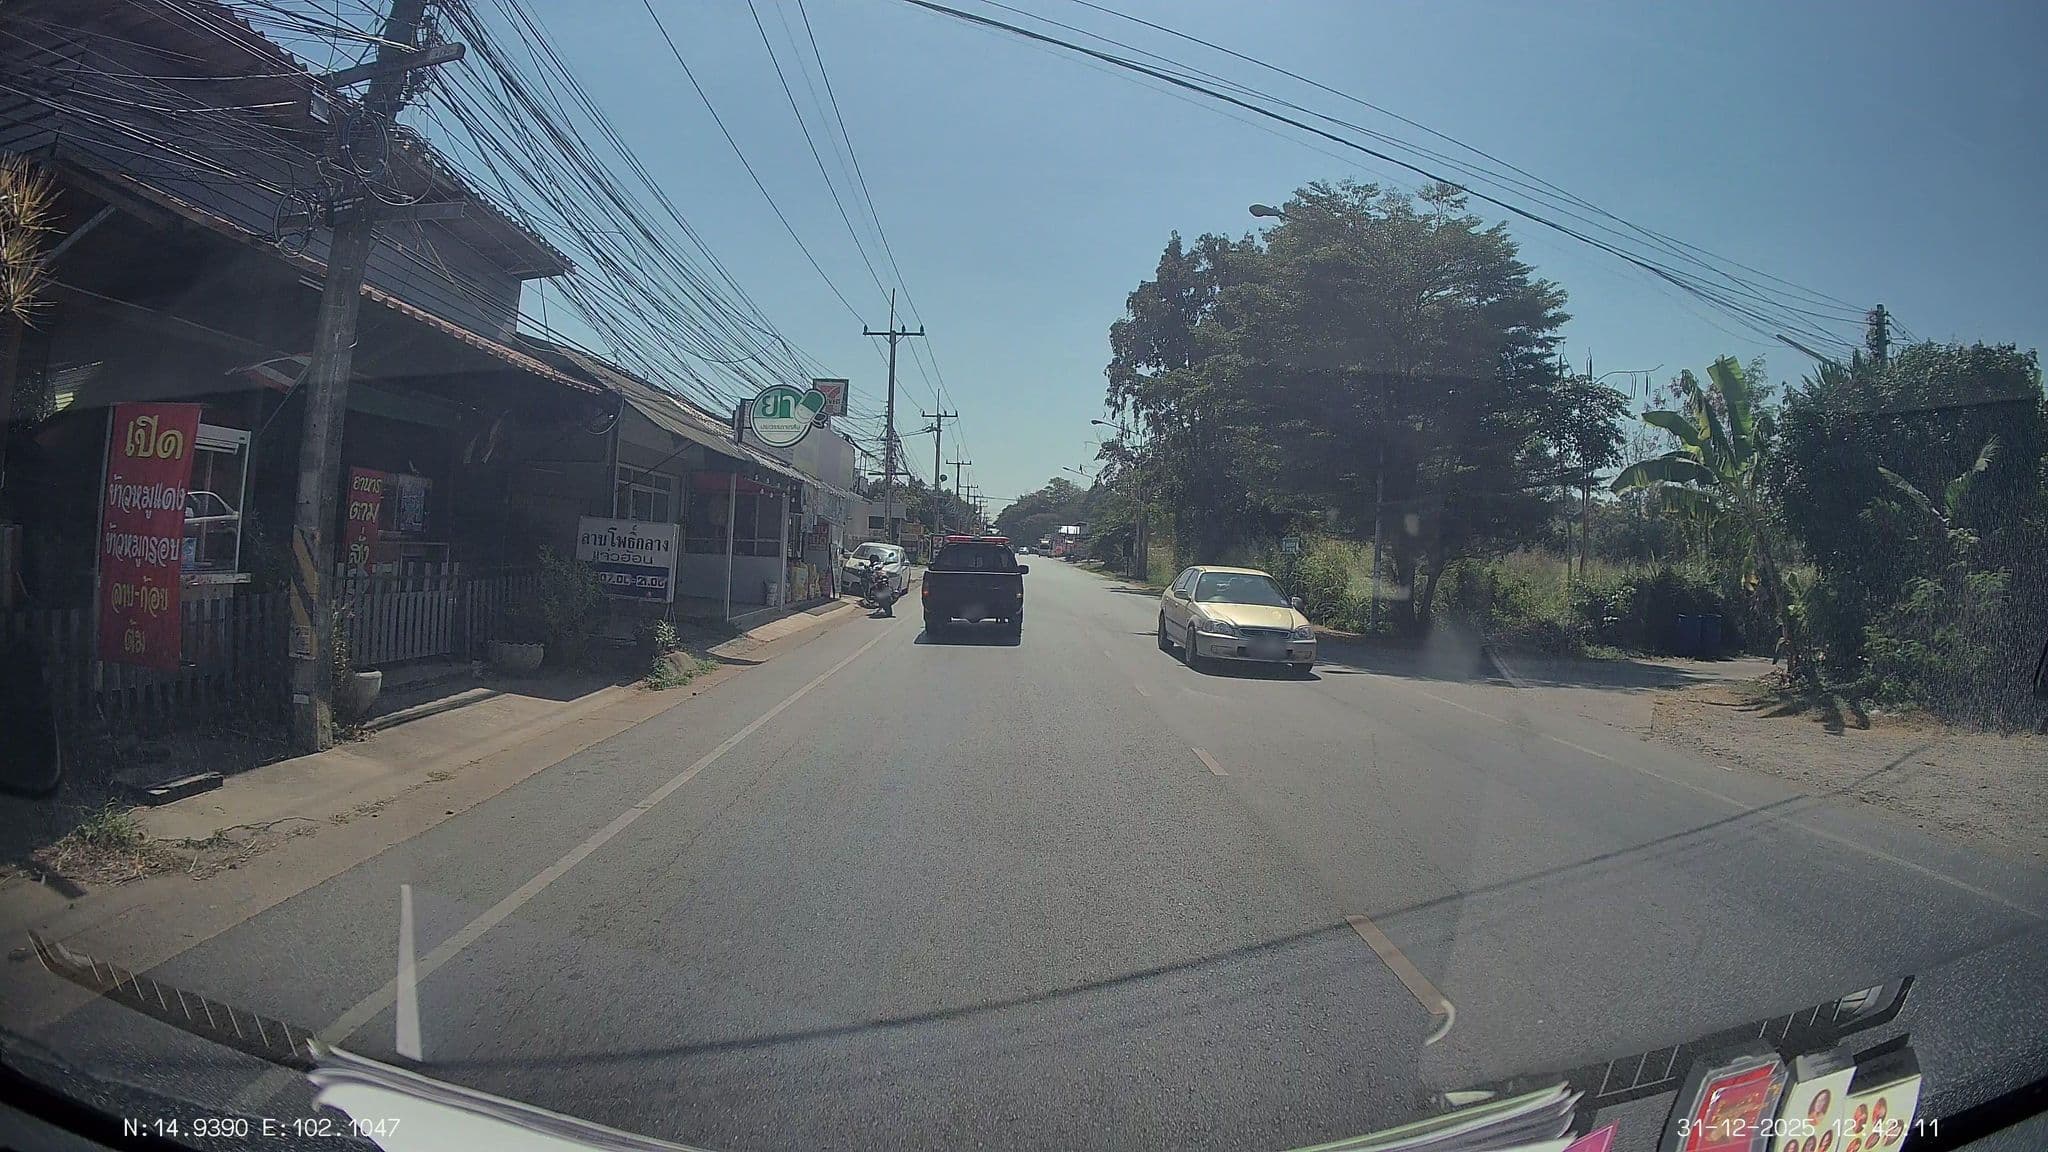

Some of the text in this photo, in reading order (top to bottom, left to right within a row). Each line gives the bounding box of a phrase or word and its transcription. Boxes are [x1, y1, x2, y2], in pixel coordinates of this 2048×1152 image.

[761, 394, 797, 418] ยา
[125, 414, 184, 459] เปิด
[109, 473, 186, 519] ข้าวหมูแดง
[352, 475, 382, 494] อาหาร
[349, 500, 380, 523] ตาม
[105, 522, 180, 568] ข้าวหมูกรอบ
[348, 526, 370, 564] สั่ง
[581, 524, 669, 552] ลาบโพธิ์กลาง
[124, 619, 146, 656] ต้ม
